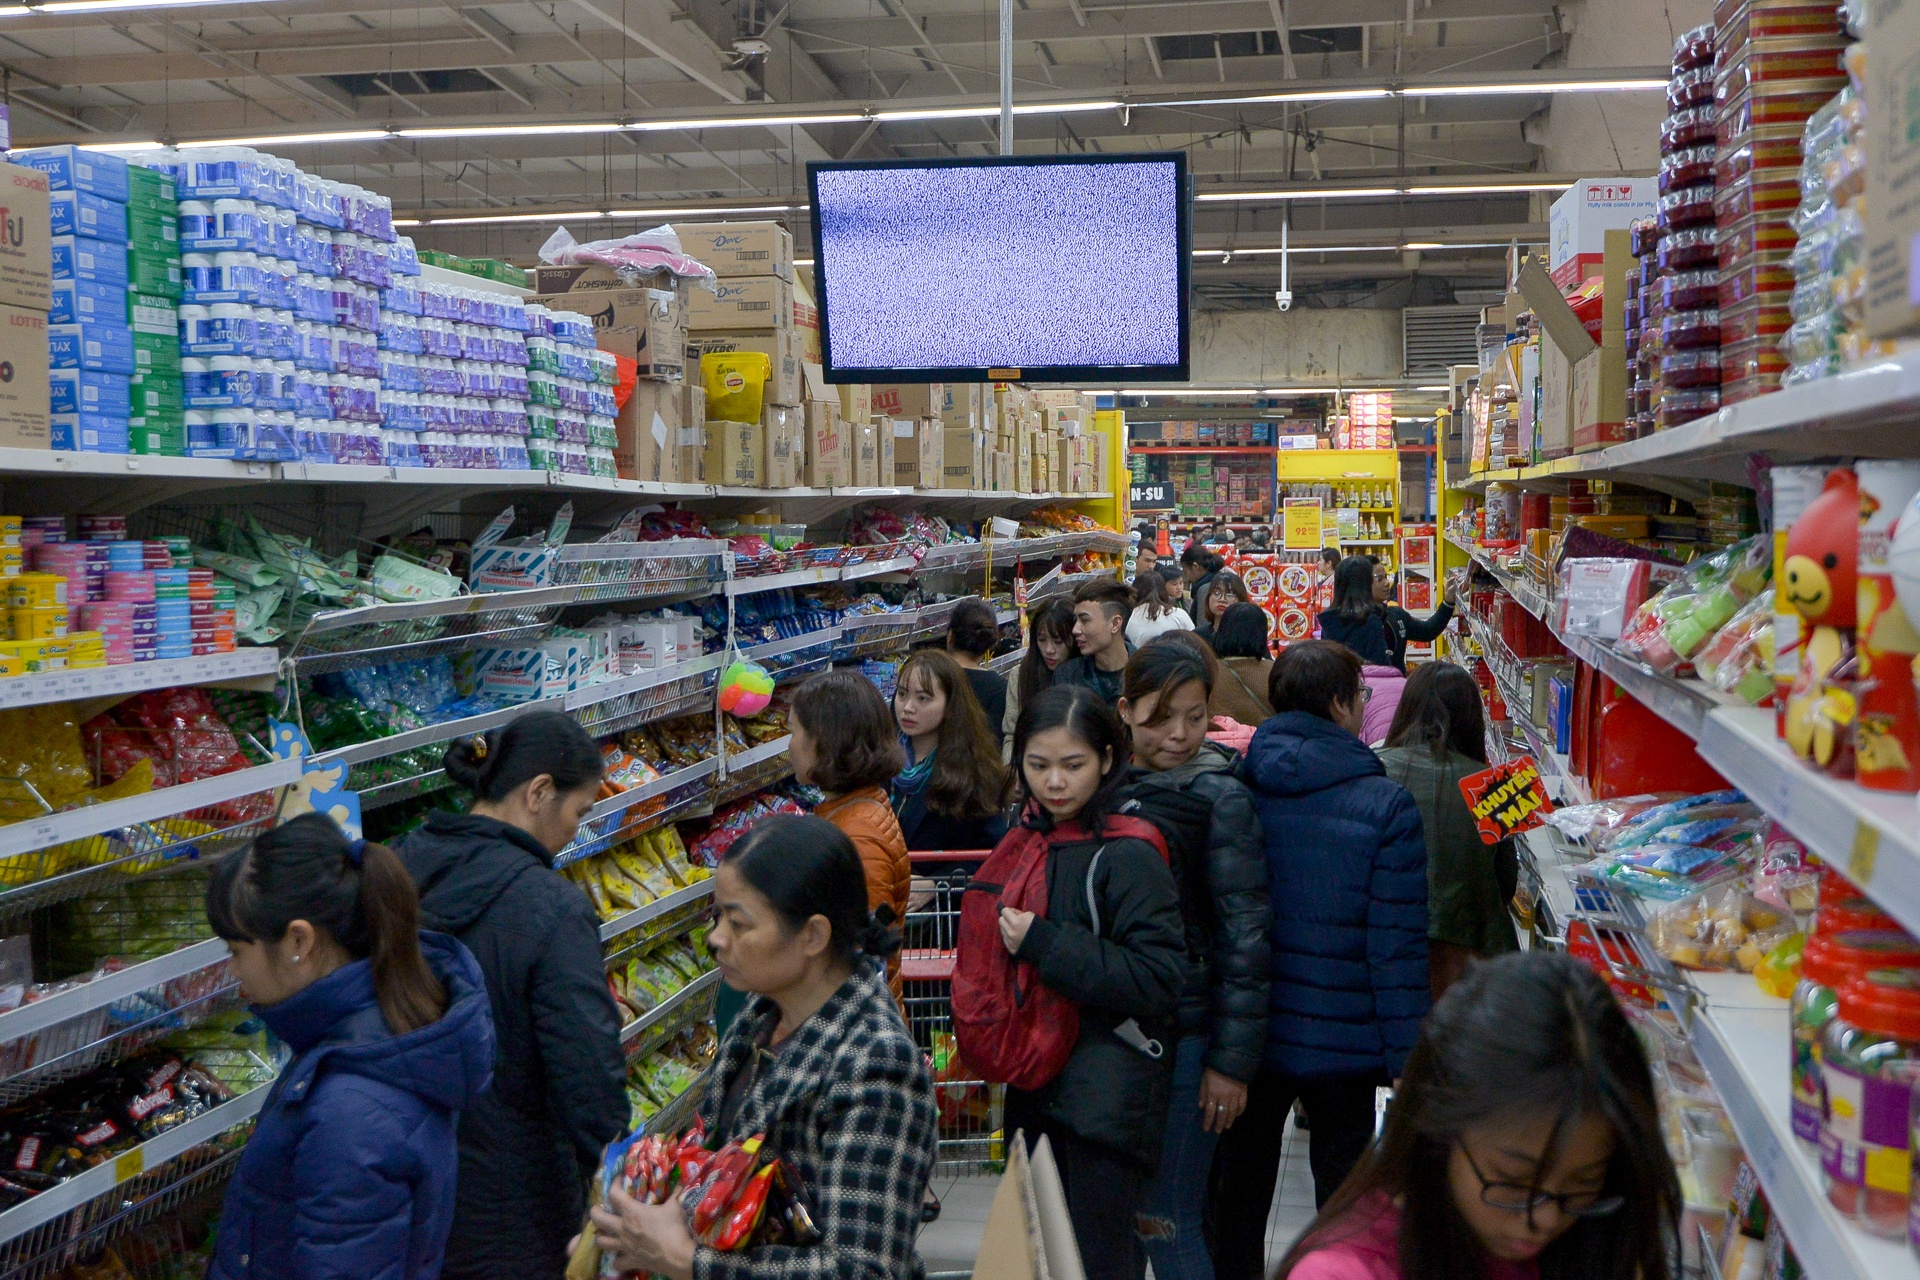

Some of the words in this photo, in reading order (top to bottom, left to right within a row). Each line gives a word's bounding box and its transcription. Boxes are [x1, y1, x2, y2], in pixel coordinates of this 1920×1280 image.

[707, 235, 748, 247] Dove
[542, 270, 571, 278] Classic
[575, 280, 623, 289] coffeeSHOT
[716, 287, 749, 299] Dove
[10, 314, 45, 330] LOTTE
[1295, 527, 1307, 536] 92
[480, 576, 515, 586] FISHERMAN'S
[484, 676, 515, 685] FISHERMAN'S
[515, 677, 533, 687] FRIEND
[1472, 764, 1539, 820] KHUYẾN
